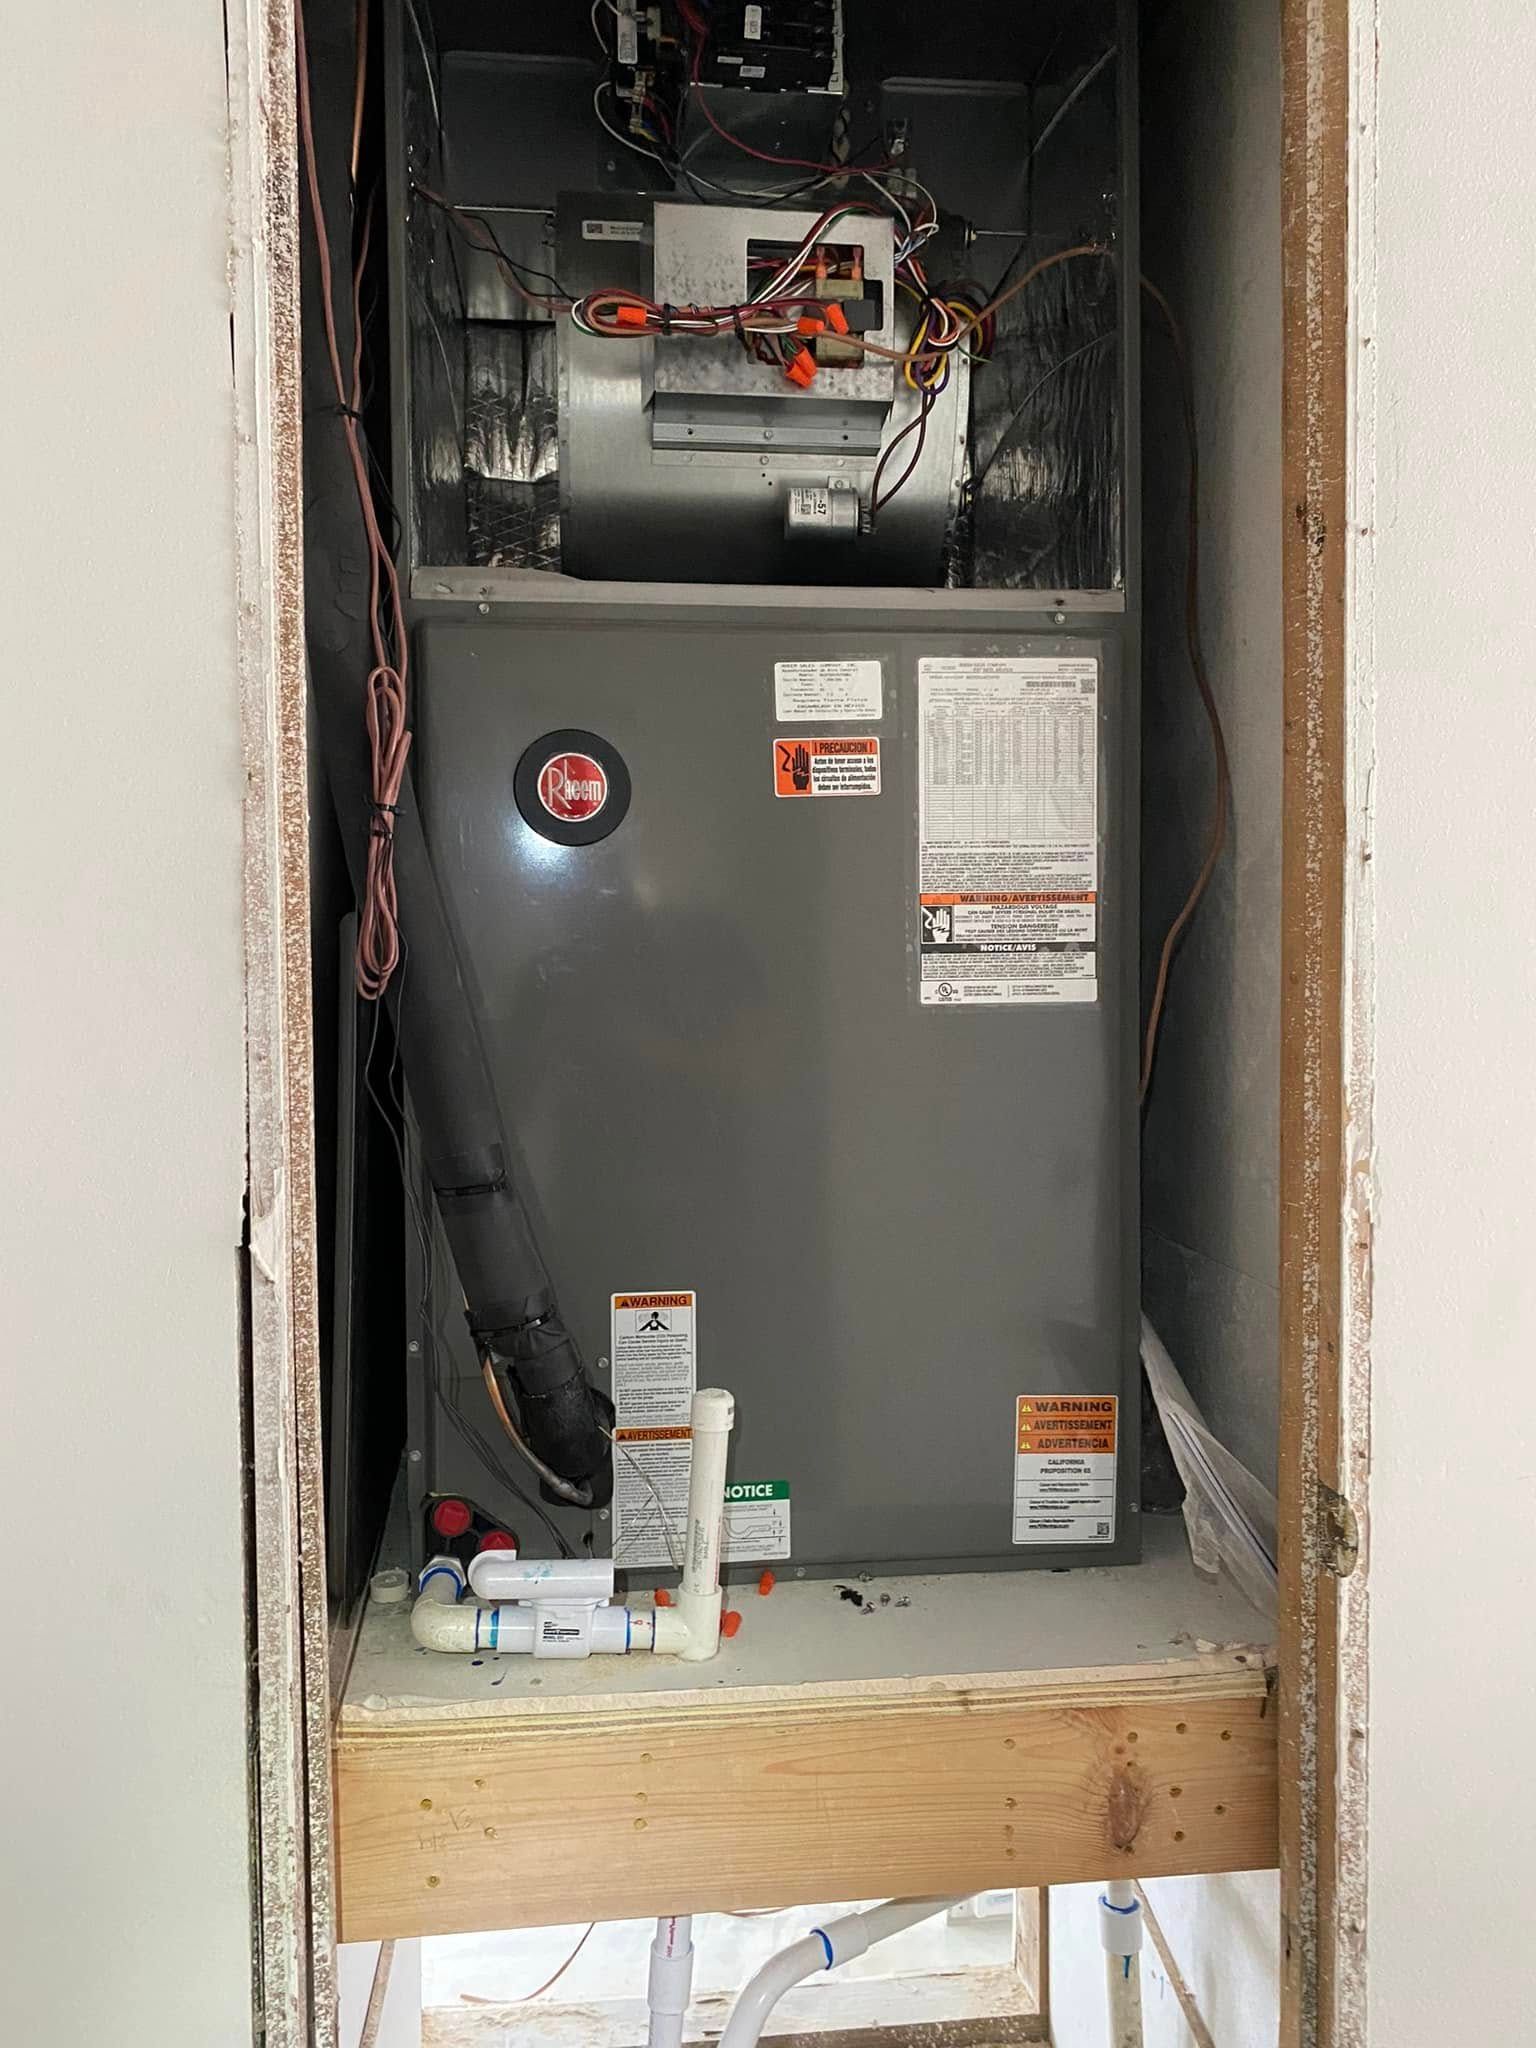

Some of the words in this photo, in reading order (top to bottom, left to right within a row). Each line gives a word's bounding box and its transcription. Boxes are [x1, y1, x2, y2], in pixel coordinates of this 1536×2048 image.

[819, 742, 868, 753] PRECAUCION
[547, 759, 602, 809] Rheem
[960, 894, 1089, 903] WARNING/AVERTISSEMENT
[980, 944, 1037, 952] NOTICE/AVIS
[630, 1295, 687, 1307] WARNING
[1035, 1402, 1112, 1412] WARNING
[1034, 1420, 1113, 1430] AVERTISSEMENT
[628, 1429, 693, 1440] AVERTISSEMENT
[1038, 1438, 1109, 1449] ADVERTENCIA
